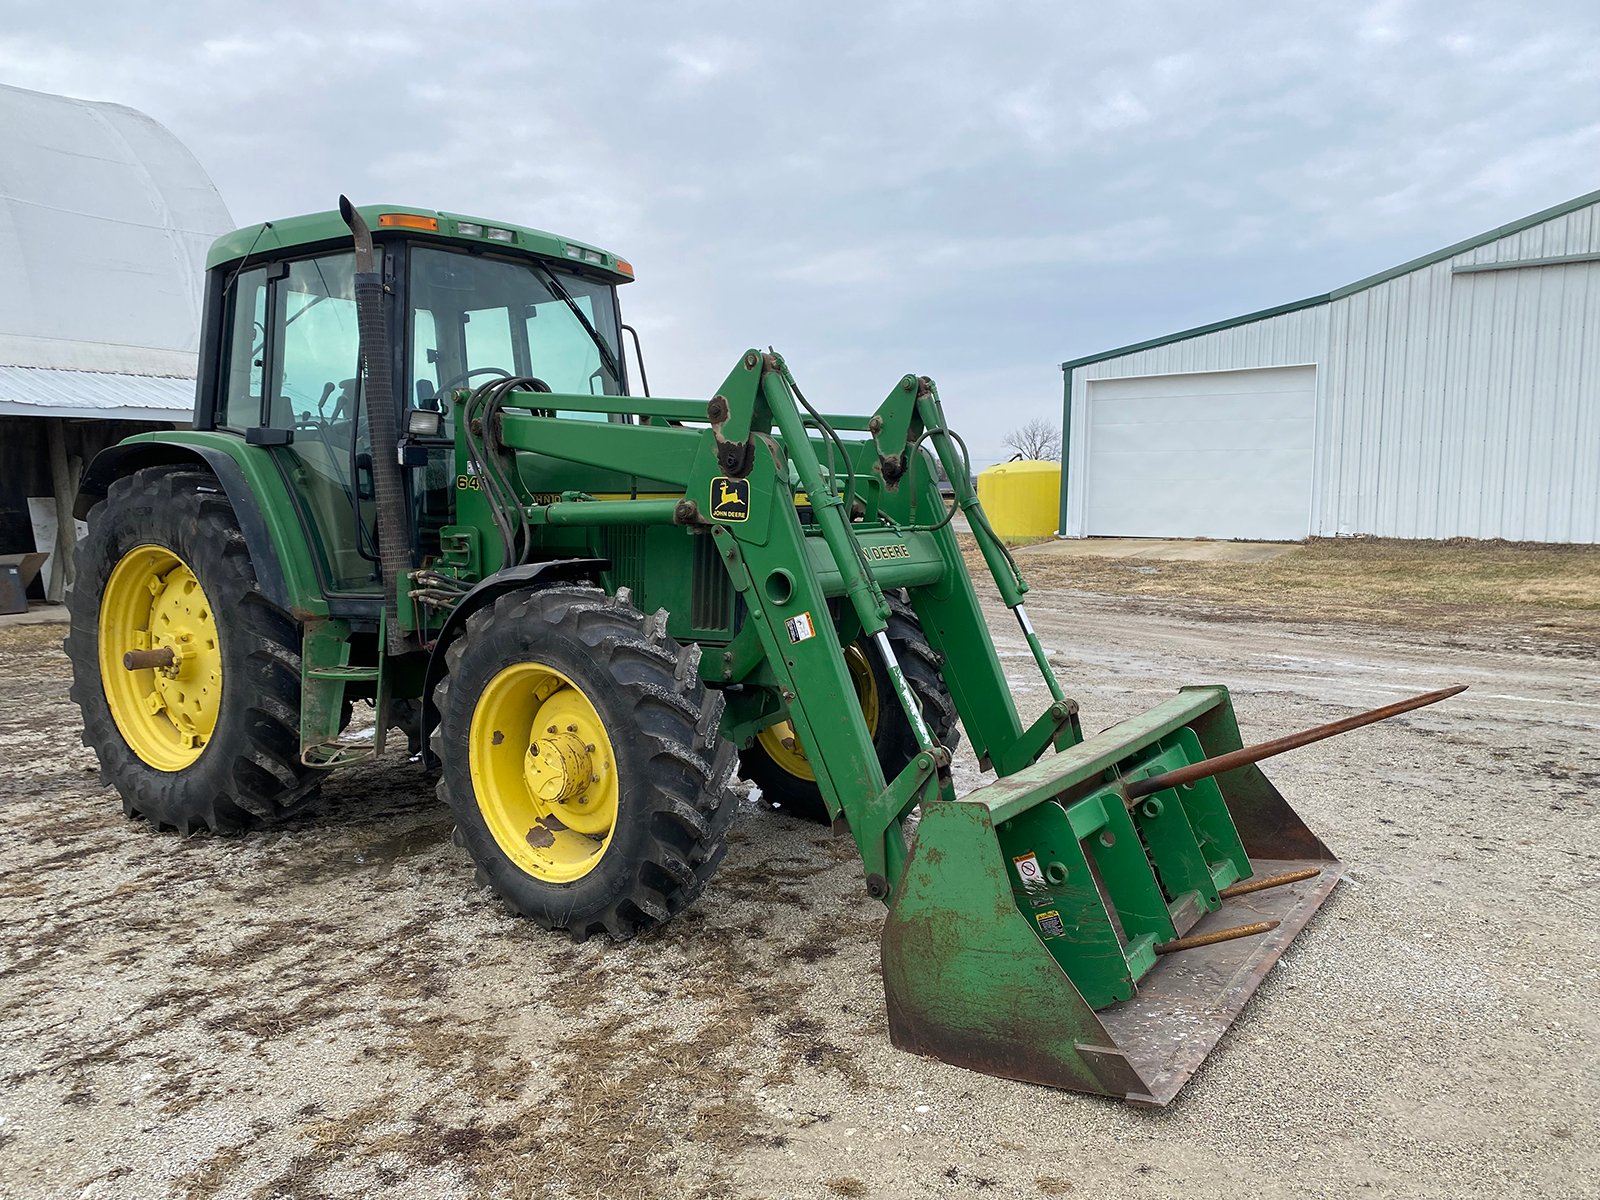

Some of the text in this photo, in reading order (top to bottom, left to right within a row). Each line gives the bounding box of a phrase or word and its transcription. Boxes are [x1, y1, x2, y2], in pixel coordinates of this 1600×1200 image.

[457, 474, 482, 491] 64
[713, 510, 746, 519] JOHN DEERE
[870, 544, 910, 561] DEERE
